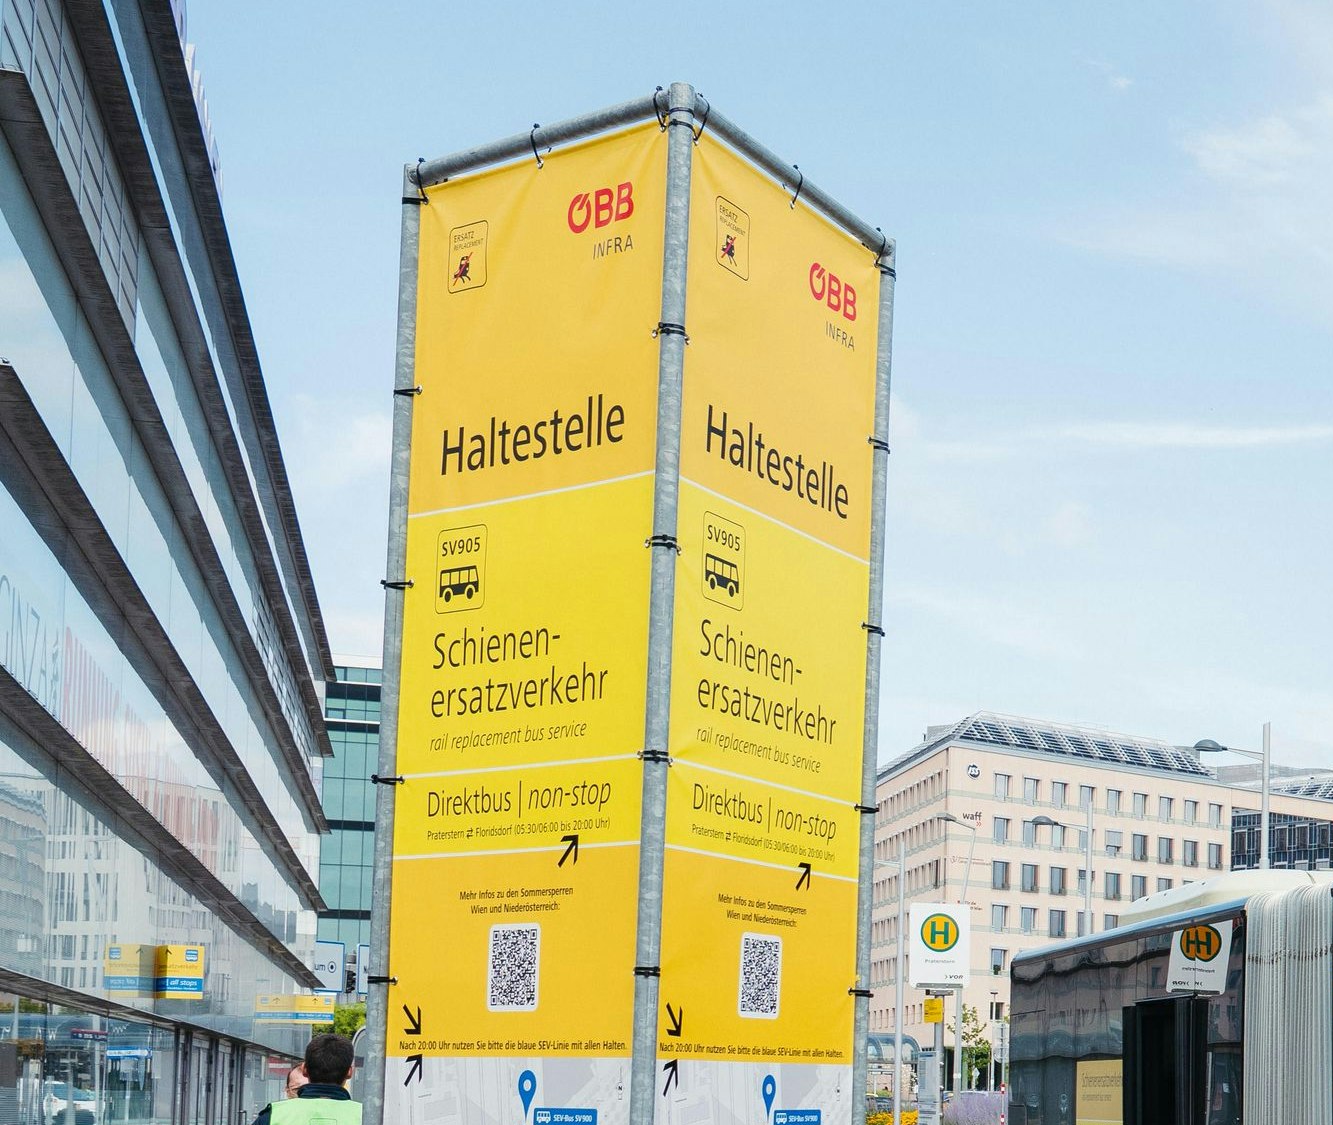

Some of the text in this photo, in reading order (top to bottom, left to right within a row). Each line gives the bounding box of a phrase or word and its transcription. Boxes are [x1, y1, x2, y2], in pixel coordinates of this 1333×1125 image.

[568, 182, 634, 233] ÖBB
[719, 204, 738, 222] ERSATZ
[454, 231, 475, 243] ERSATZ
[593, 235, 634, 260] INFRA
[809, 262, 857, 321] ÖBB
[825, 320, 855, 351] INFRA
[441, 393, 625, 475] Haltestelle
[706, 404, 849, 519] Haltestelle
[441, 536, 481, 556] SV905
[707, 524, 741, 551] SV905
[432, 626, 561, 670] Schienen-
[700, 619, 802, 685] Schienen-
[430, 662, 608, 718] ersatzverkehr
[697, 678, 836, 745] ersatzverkehr
[430, 721, 587, 753] rail replacement bus service
[696, 727, 821, 773] rail replacement bus service
[427, 780, 611, 817] Direktbus non-stop
[693, 783, 837, 845] Direktbus non-stop
[962, 811, 982, 821] waff
[427, 830, 465, 841] Praterstern
[475, 825, 513, 837] Floridsdorf
[560, 820, 572, 831] bis
[573, 819, 593, 831] 20:00
[595, 817, 611, 829] Uhr)
[692, 823, 725, 840] Praterstern
[732, 832, 763, 847] Floridsdorf
[460, 886, 573, 900] Mehr Infos zu den Sommersperren
[718, 893, 732, 904] Mehr
[733, 896, 747, 906] Infos
[748, 899, 755, 908] zu
[755, 900, 766, 909] den
[470, 901, 560, 915] Wien und Niederösterreich:
[726, 909, 741, 920] Wien
[741, 912, 752, 921] und
[930, 921, 950, 945] H
[400, 1040, 627, 1050] Nach 20:00 Uhr nutzen Sie bitte die blaue SEV-Linie mit allen Halten.
[660, 1042, 674, 1052] Nach
[676, 1043, 692, 1053] 20:00
[693, 1043, 705, 1053] Uhr
[706, 1045, 726, 1054] nutzen
[727, 1045, 736, 1054] Sie
[737, 1046, 751, 1055] bitte
[752, 1046, 761, 1055] die
[762, 1046, 776, 1056] blaue
[802, 1048, 811, 1057] mit
[812, 1048, 825, 1057] allen
[553, 1114, 574, 1122] SEV-Bus
